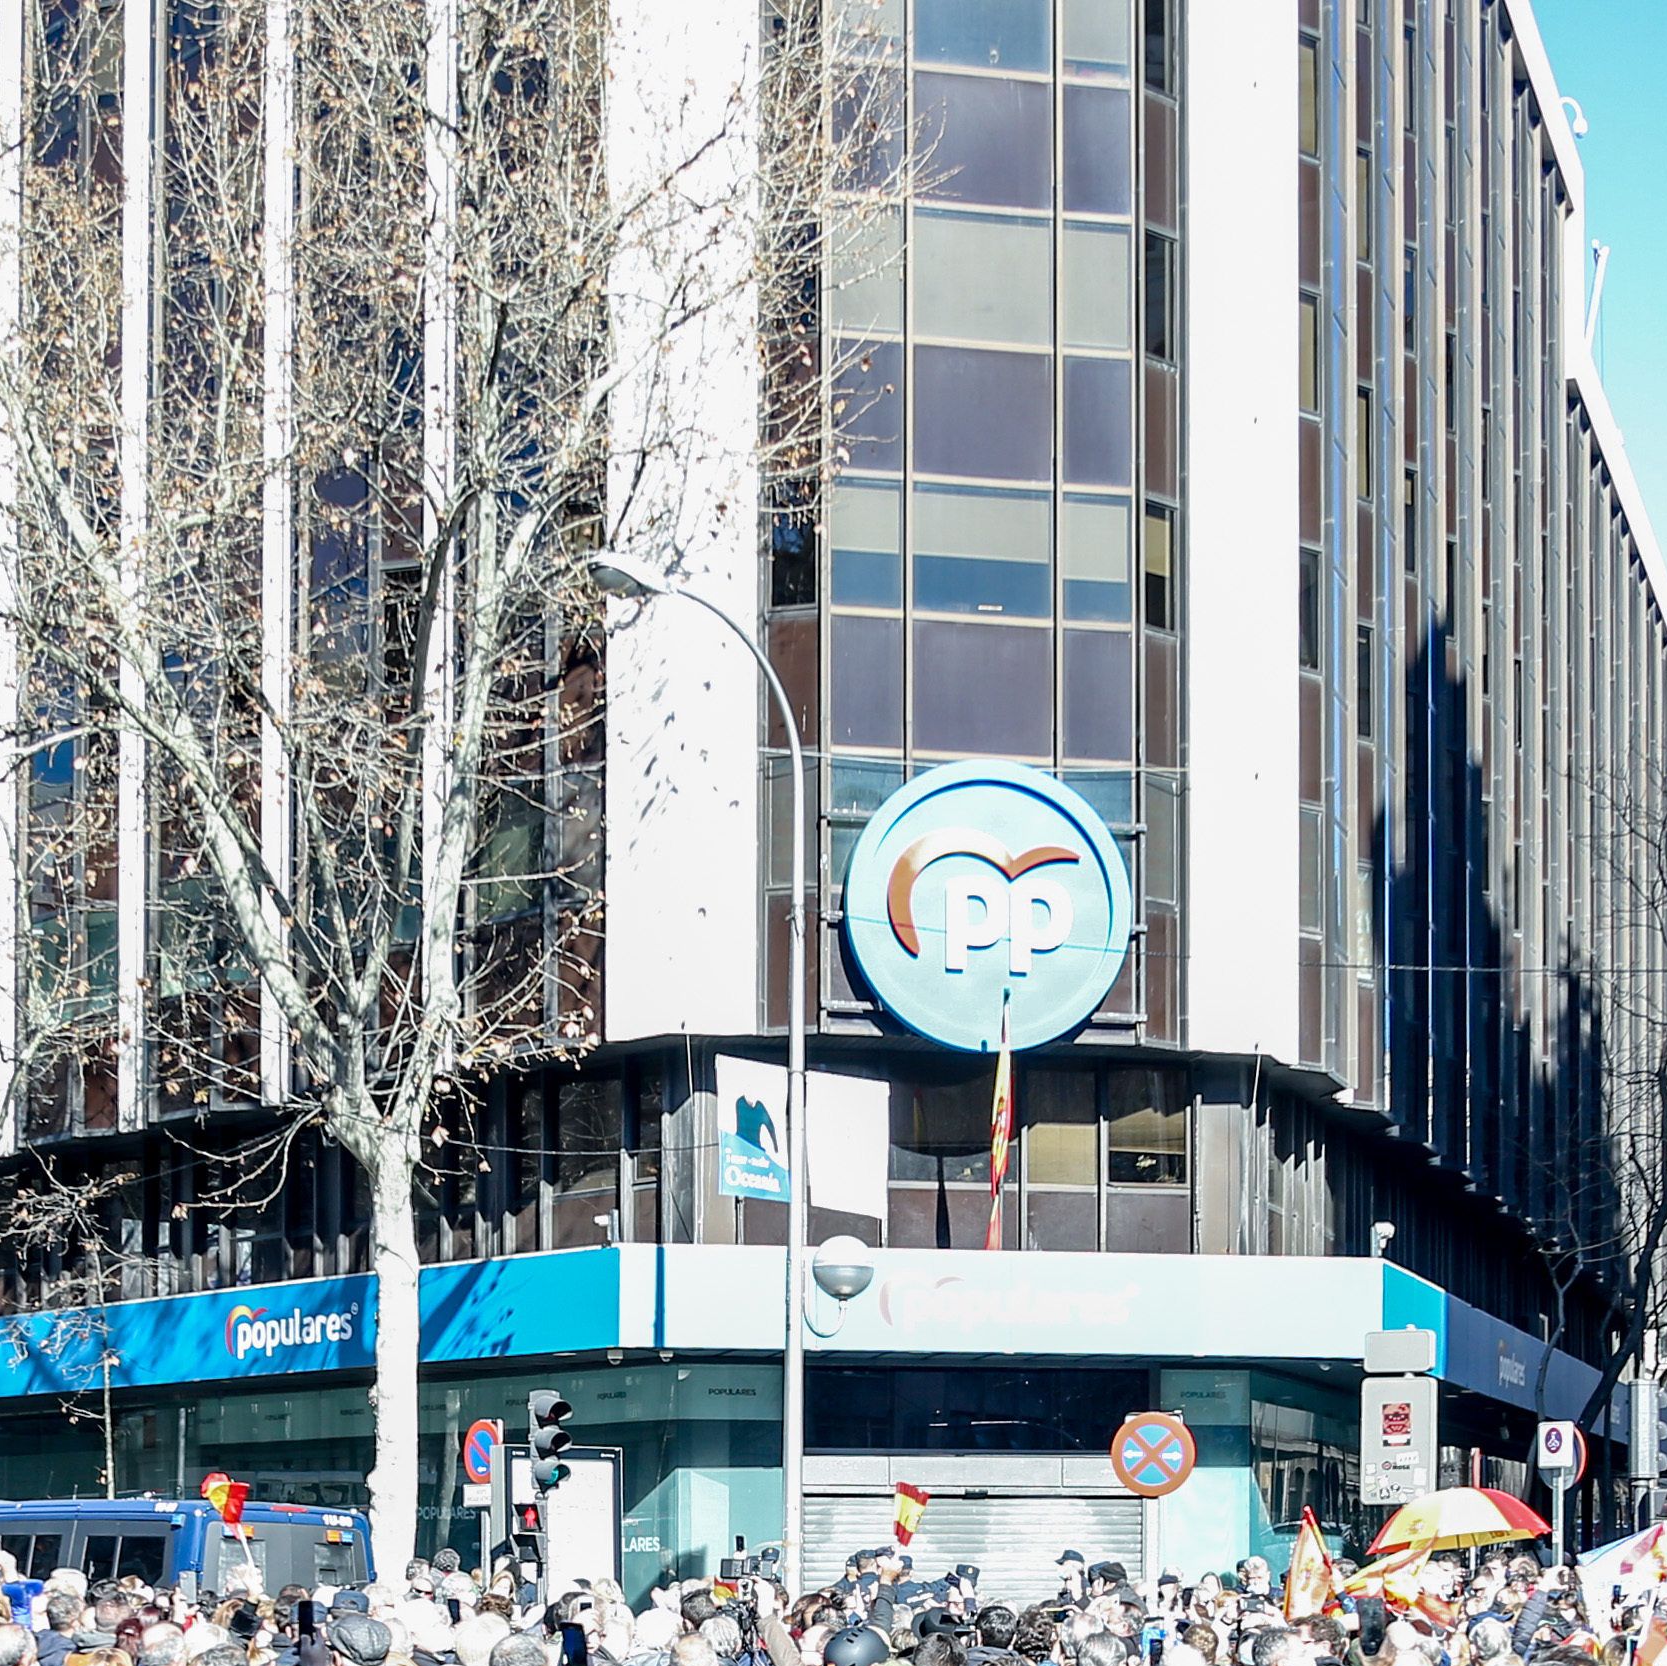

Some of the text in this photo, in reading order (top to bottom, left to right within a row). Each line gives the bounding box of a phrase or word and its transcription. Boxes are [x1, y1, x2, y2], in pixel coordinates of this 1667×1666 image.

[902, 1280, 1131, 1332] populares
[237, 1307, 353, 1360] populares
[708, 1387, 757, 1396] POPULARES
